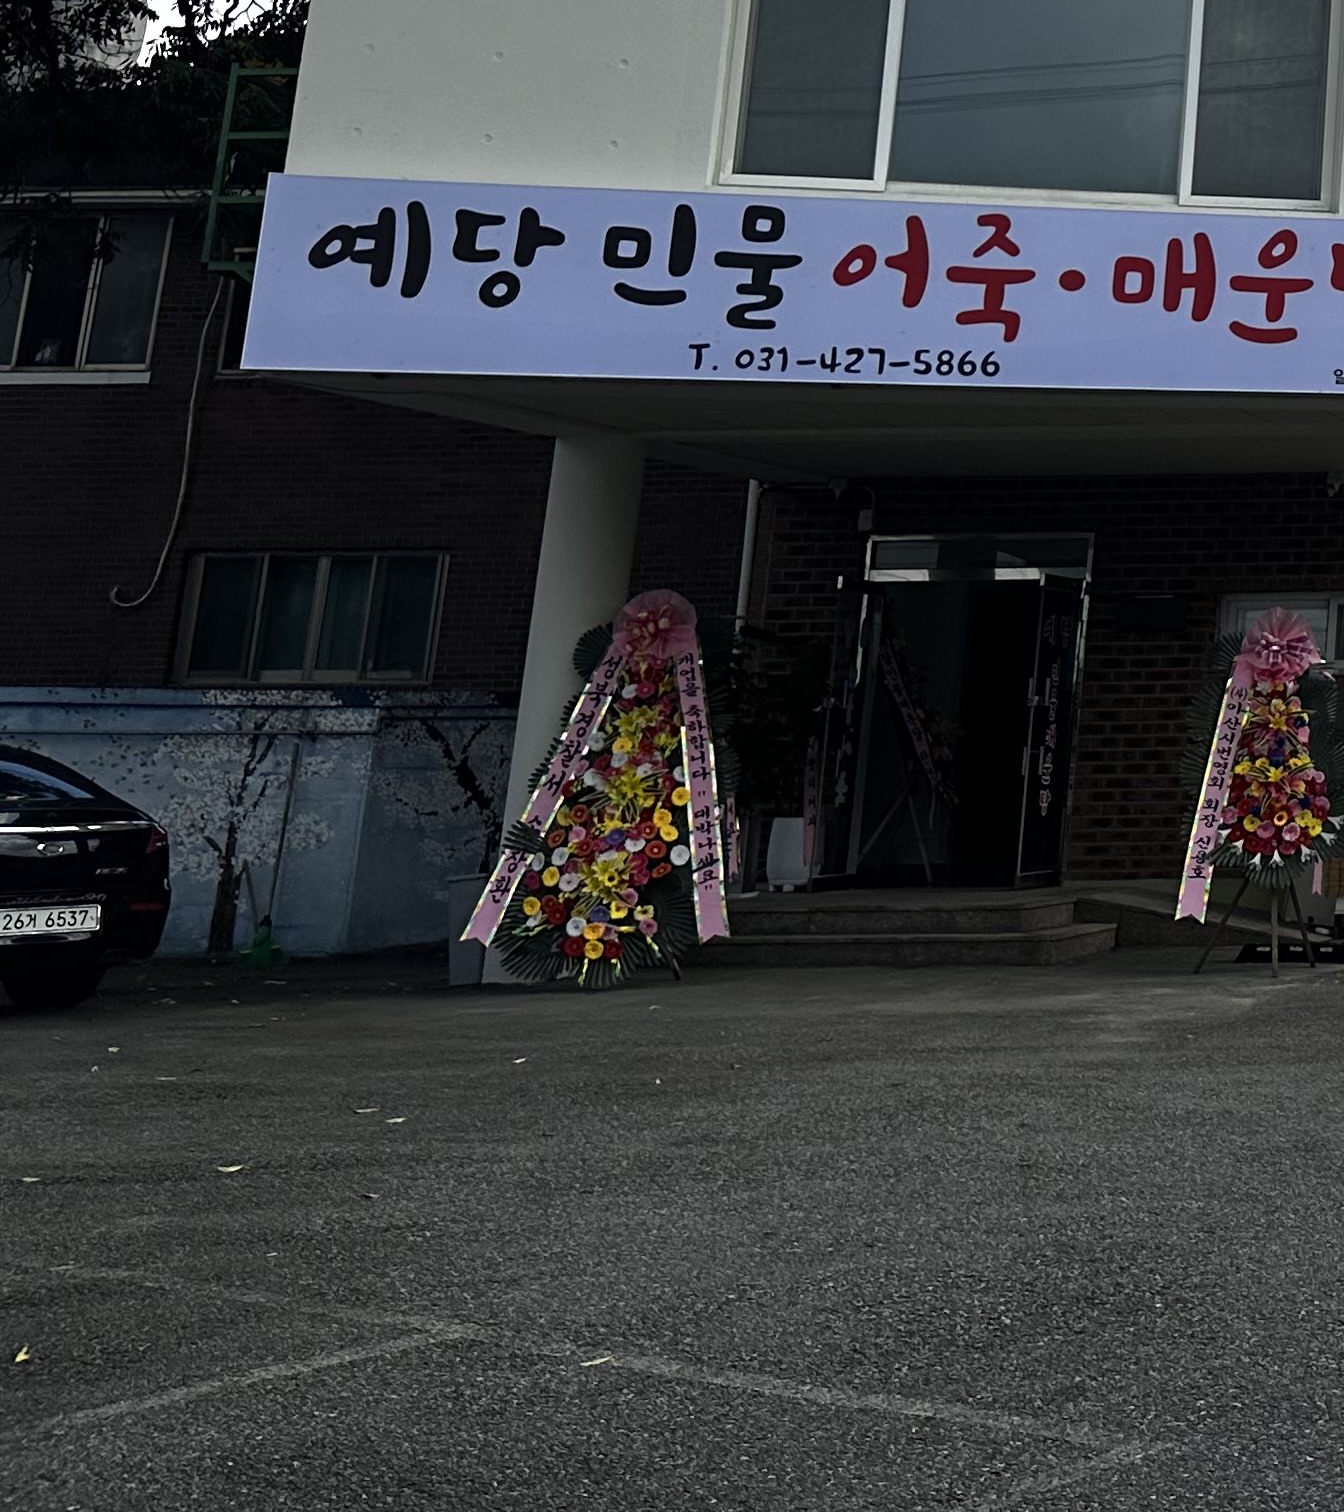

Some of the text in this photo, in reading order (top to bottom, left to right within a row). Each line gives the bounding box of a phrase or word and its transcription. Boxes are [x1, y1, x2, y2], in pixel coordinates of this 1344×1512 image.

[308, 201, 566, 308] 예당
[602, 204, 803, 330] 민물
[734, 347, 1001, 377] 031-427-5866
[678, 652, 700, 697] 개업을
[1199, 798, 1221, 829] 회장
[45, 910, 89, 928] 6537
